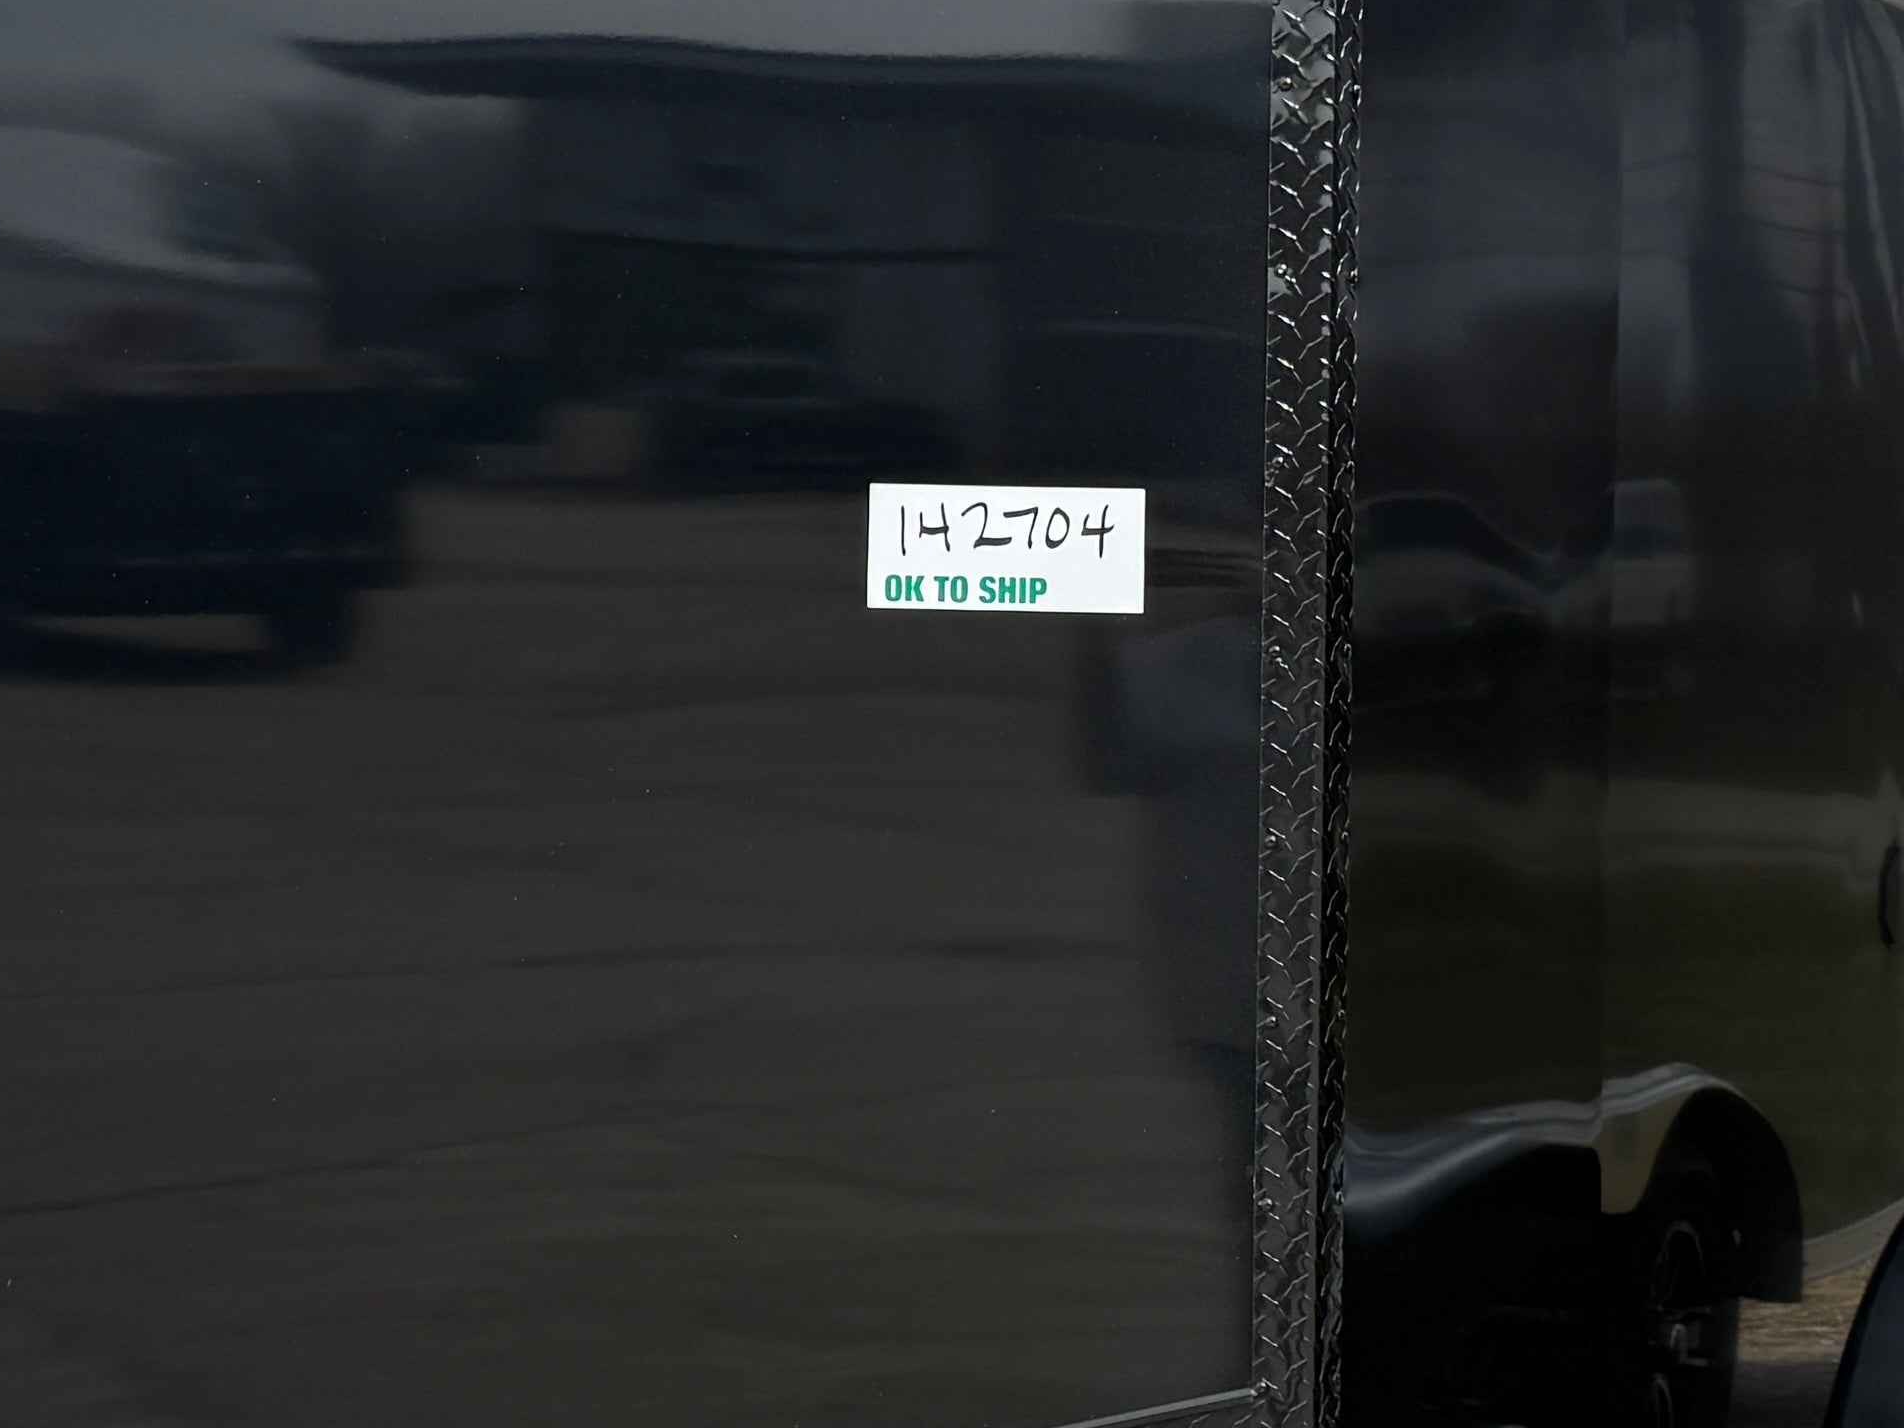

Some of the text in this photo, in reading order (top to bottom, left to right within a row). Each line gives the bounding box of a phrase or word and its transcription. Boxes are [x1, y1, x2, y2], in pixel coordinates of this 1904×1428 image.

[900, 501, 1115, 559] 142704
[884, 574, 1048, 604] OK TO SHIP
